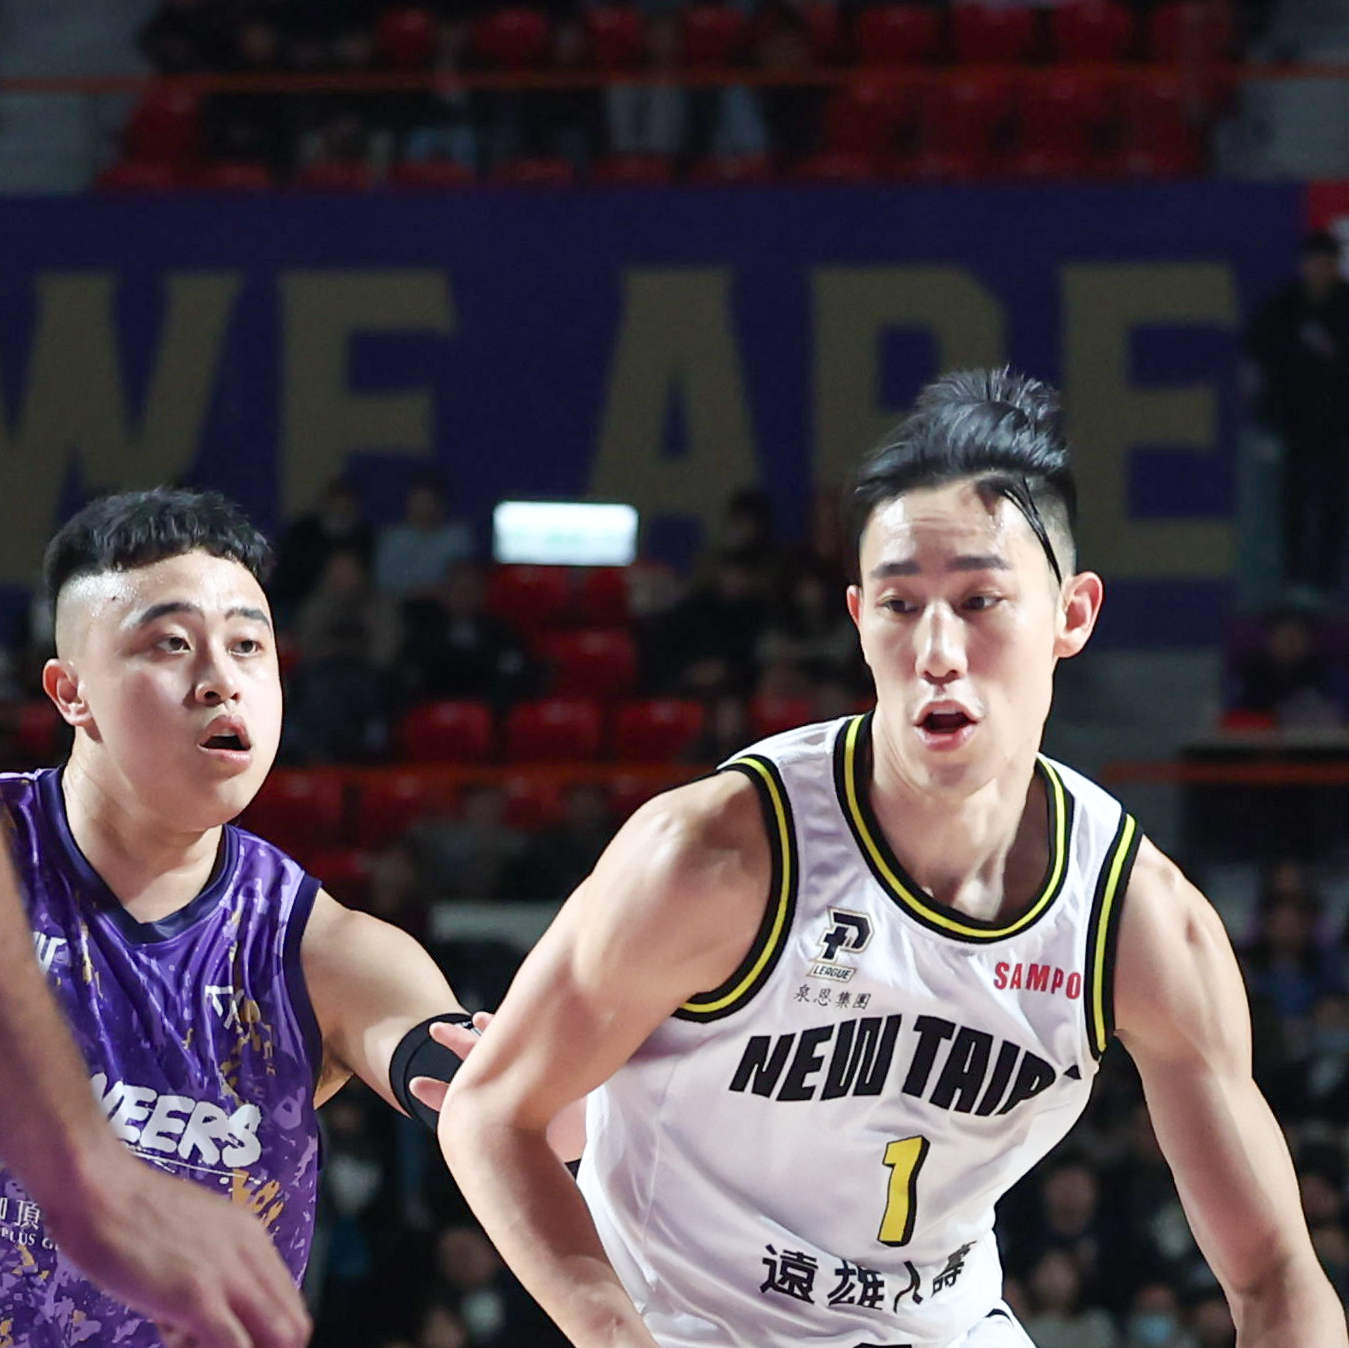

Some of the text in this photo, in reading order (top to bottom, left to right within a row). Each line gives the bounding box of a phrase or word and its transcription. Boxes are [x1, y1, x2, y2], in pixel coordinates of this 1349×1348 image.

[812, 965, 852, 981] LEAGUE
[994, 962, 1082, 1000] SAMPO
[729, 1014, 1082, 1117] NEW TAIP
[877, 1135, 931, 1248] 1
[760, 1241, 978, 1314] 遠雄人壽
